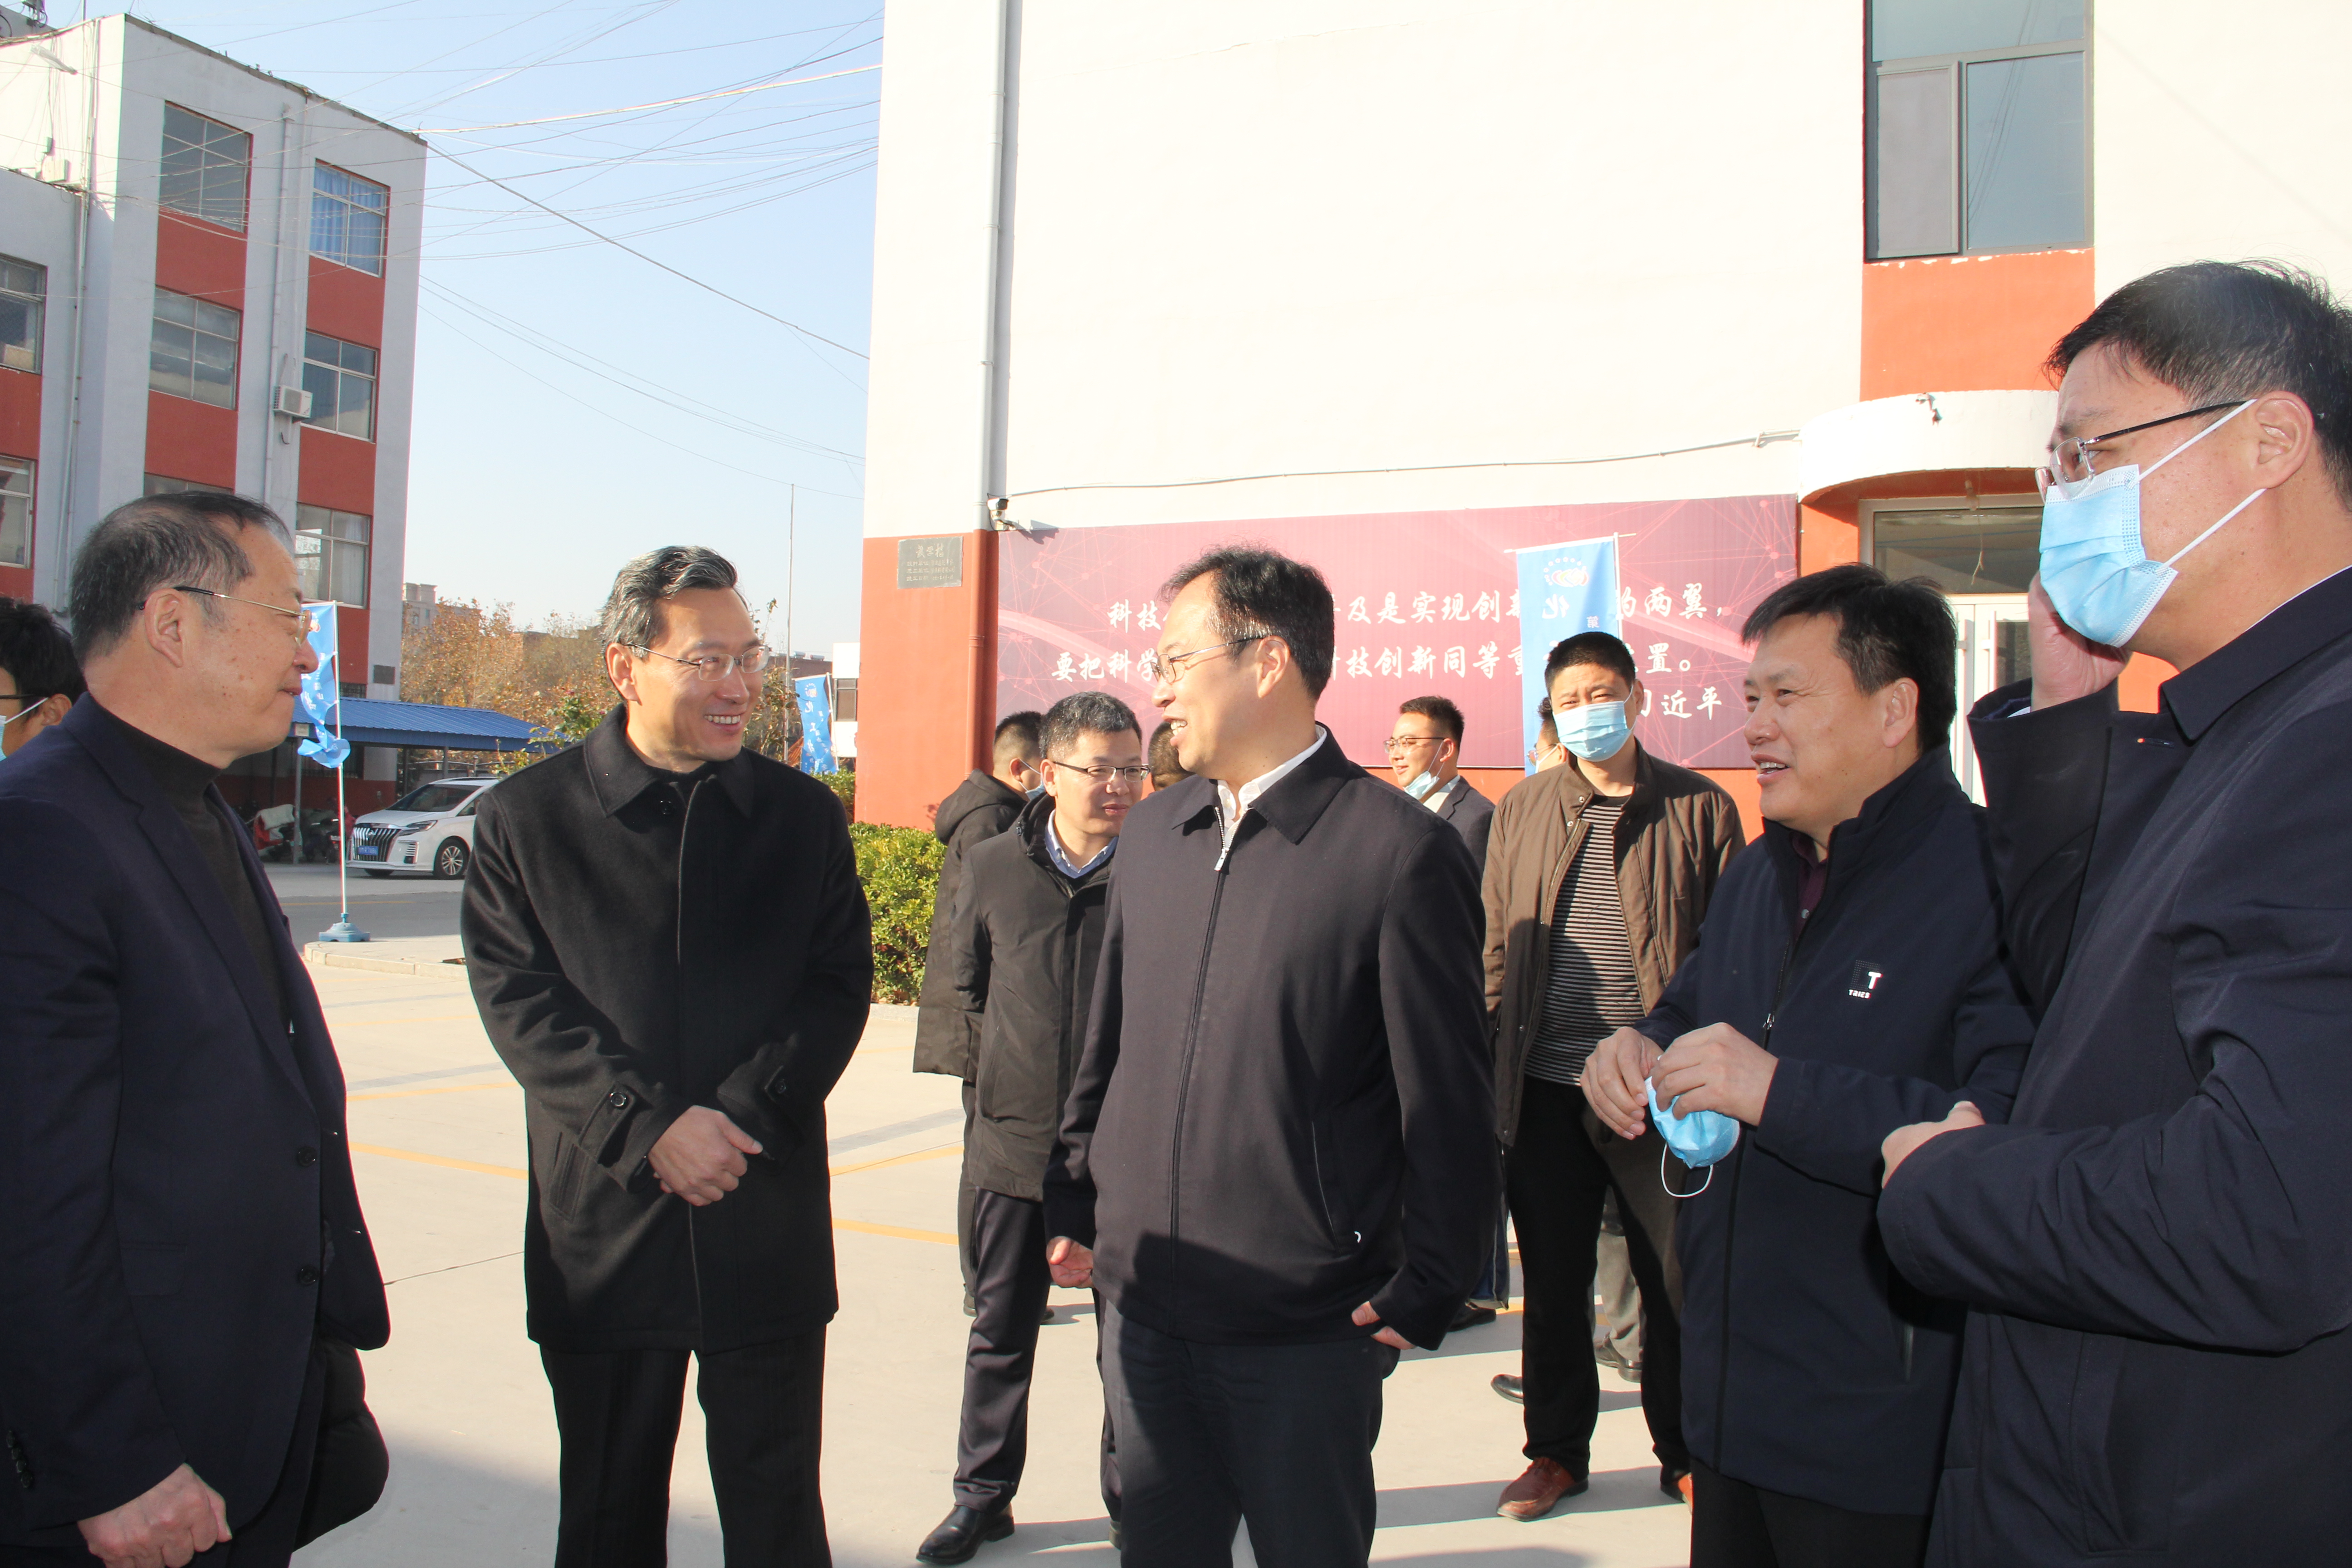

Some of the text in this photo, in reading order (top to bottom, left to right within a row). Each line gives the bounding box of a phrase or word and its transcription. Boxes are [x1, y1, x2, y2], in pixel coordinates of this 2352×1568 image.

[1107, 599, 1168, 633] 科技
[1333, 589, 1520, 625] 及是实现创新
[1051, 641, 1691, 683] 要把科学 技创新同等重 置。
[1849, 990, 1871, 999] TRIES
